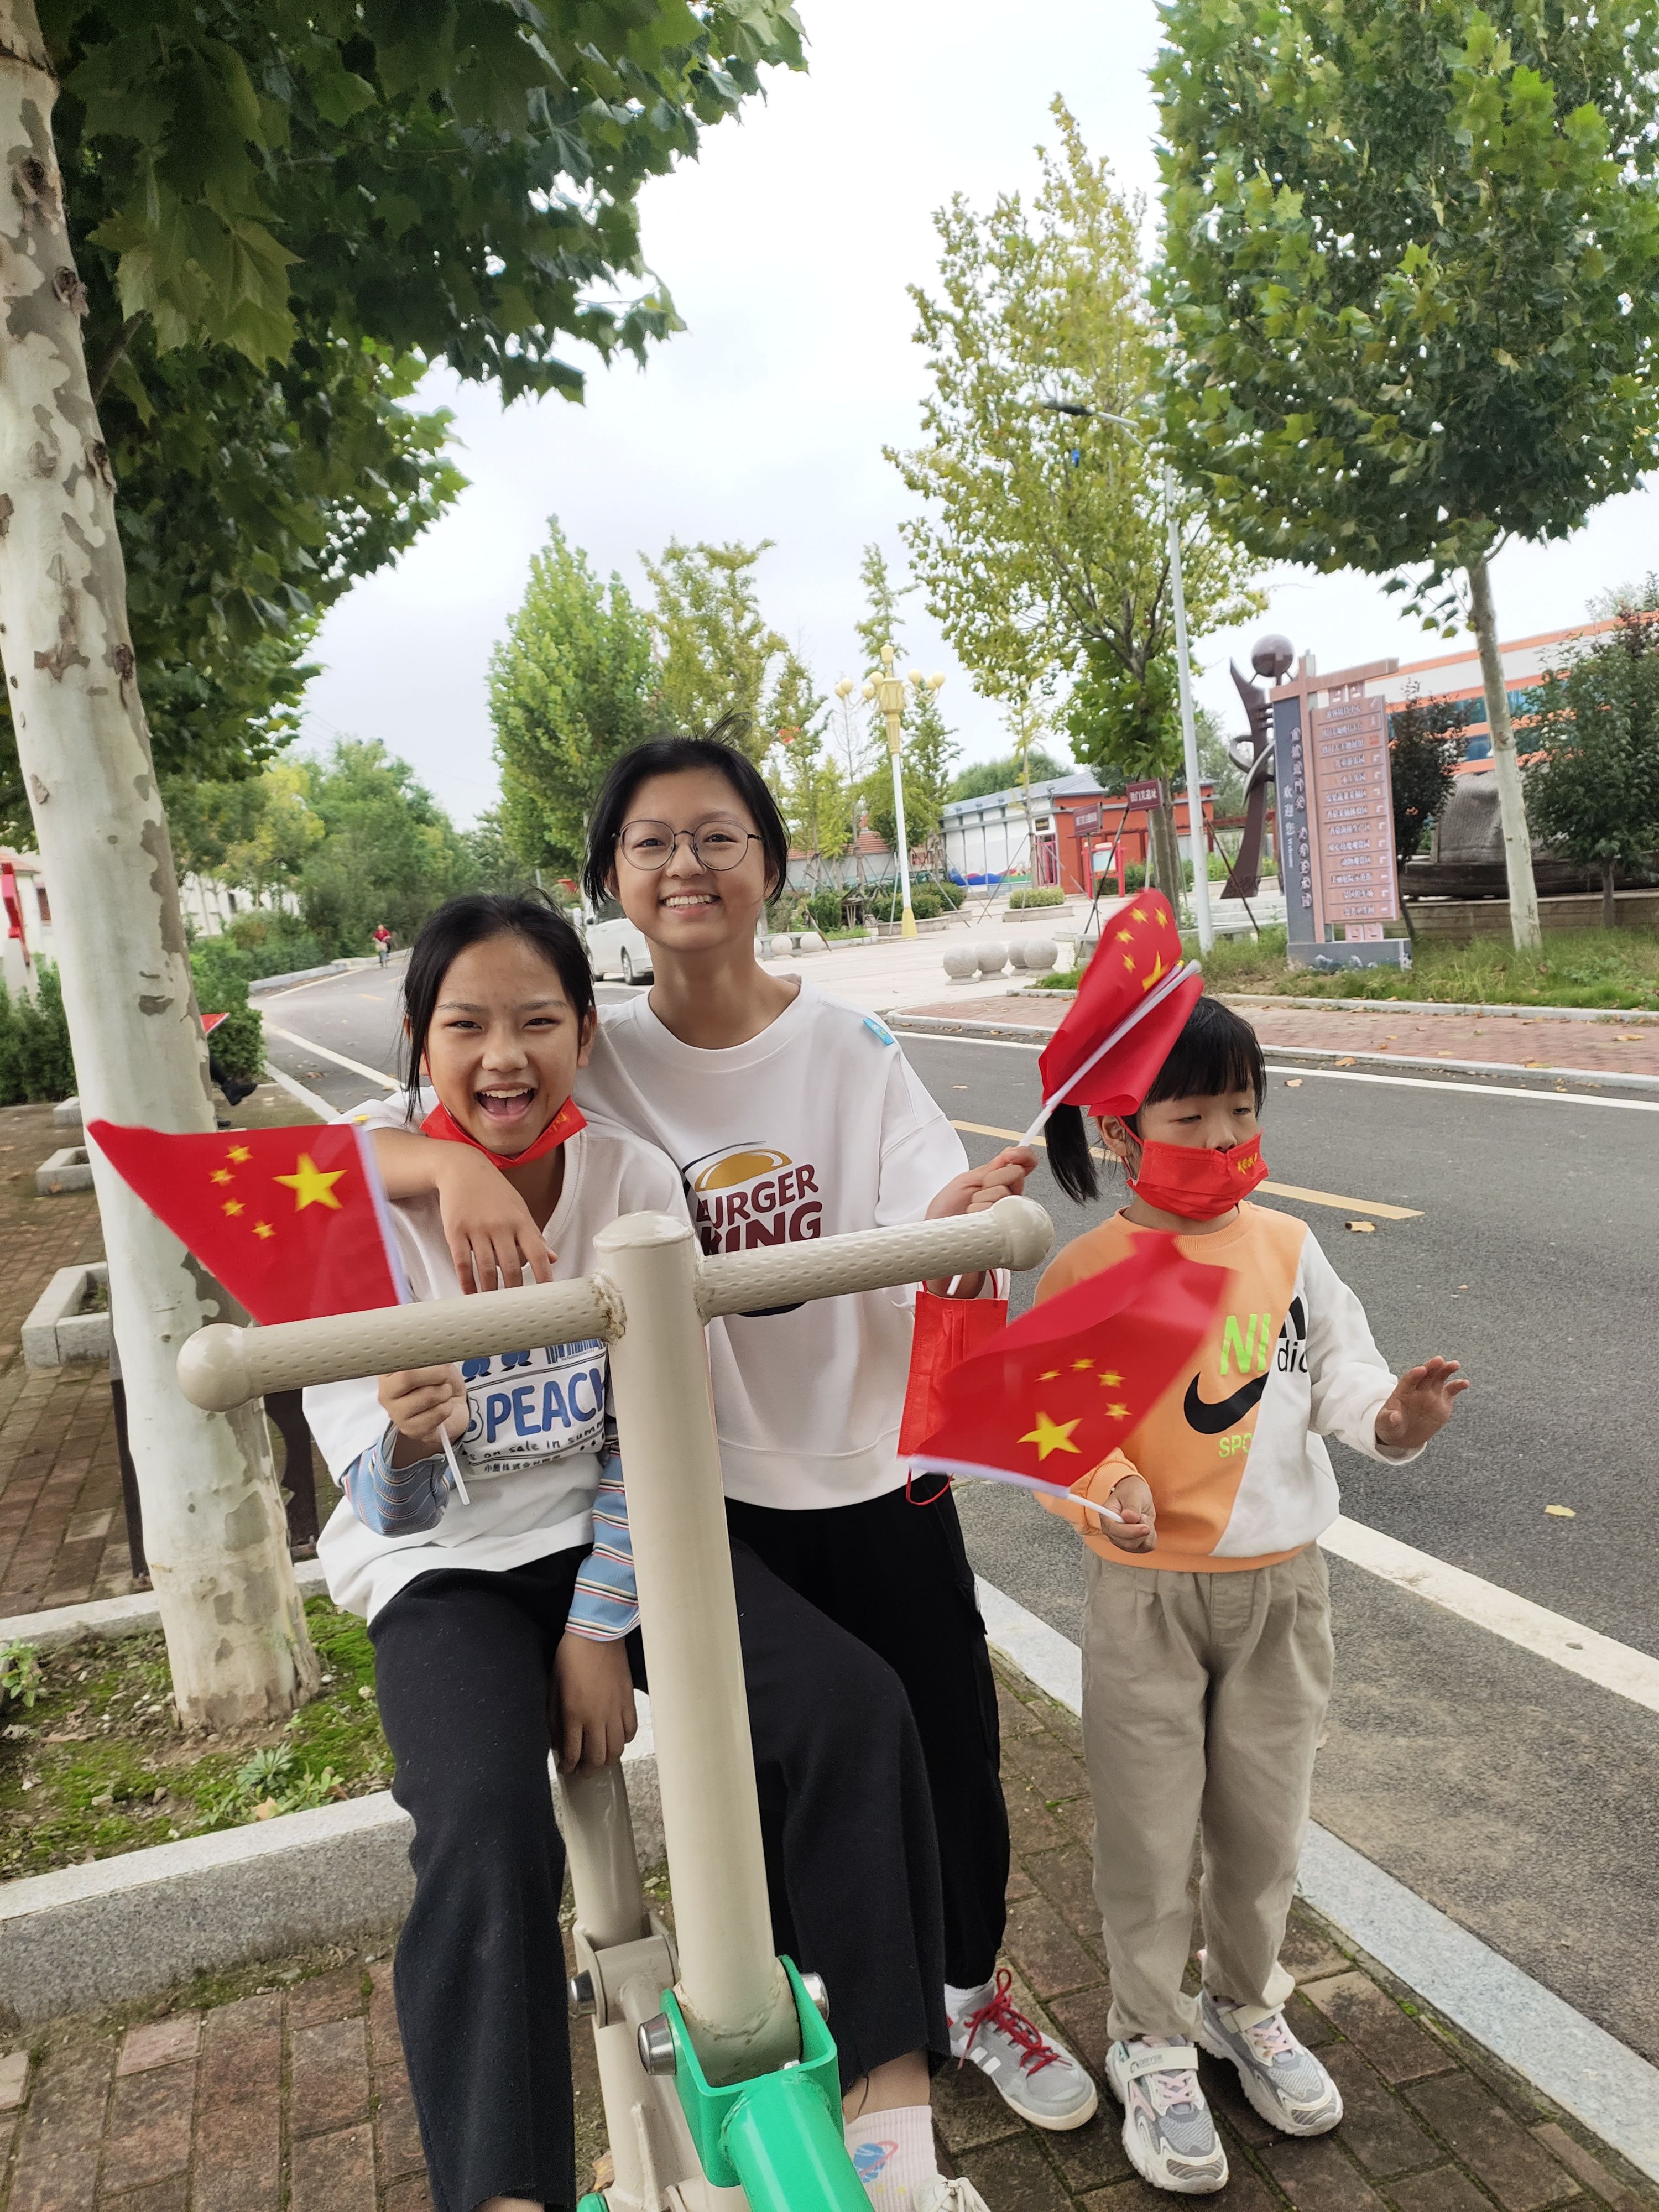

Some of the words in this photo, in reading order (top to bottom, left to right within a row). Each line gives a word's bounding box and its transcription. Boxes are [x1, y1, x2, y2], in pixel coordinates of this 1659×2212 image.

[1283, 785, 1295, 836] 欢迎您
[700, 1201, 822, 1256] KING
[1220, 1313, 1271, 1376] NI
[484, 1450, 501, 1459] on
[509, 1440, 540, 1452] sale
[546, 1439, 560, 1449] in
[1219, 1433, 1253, 1458] SPO
